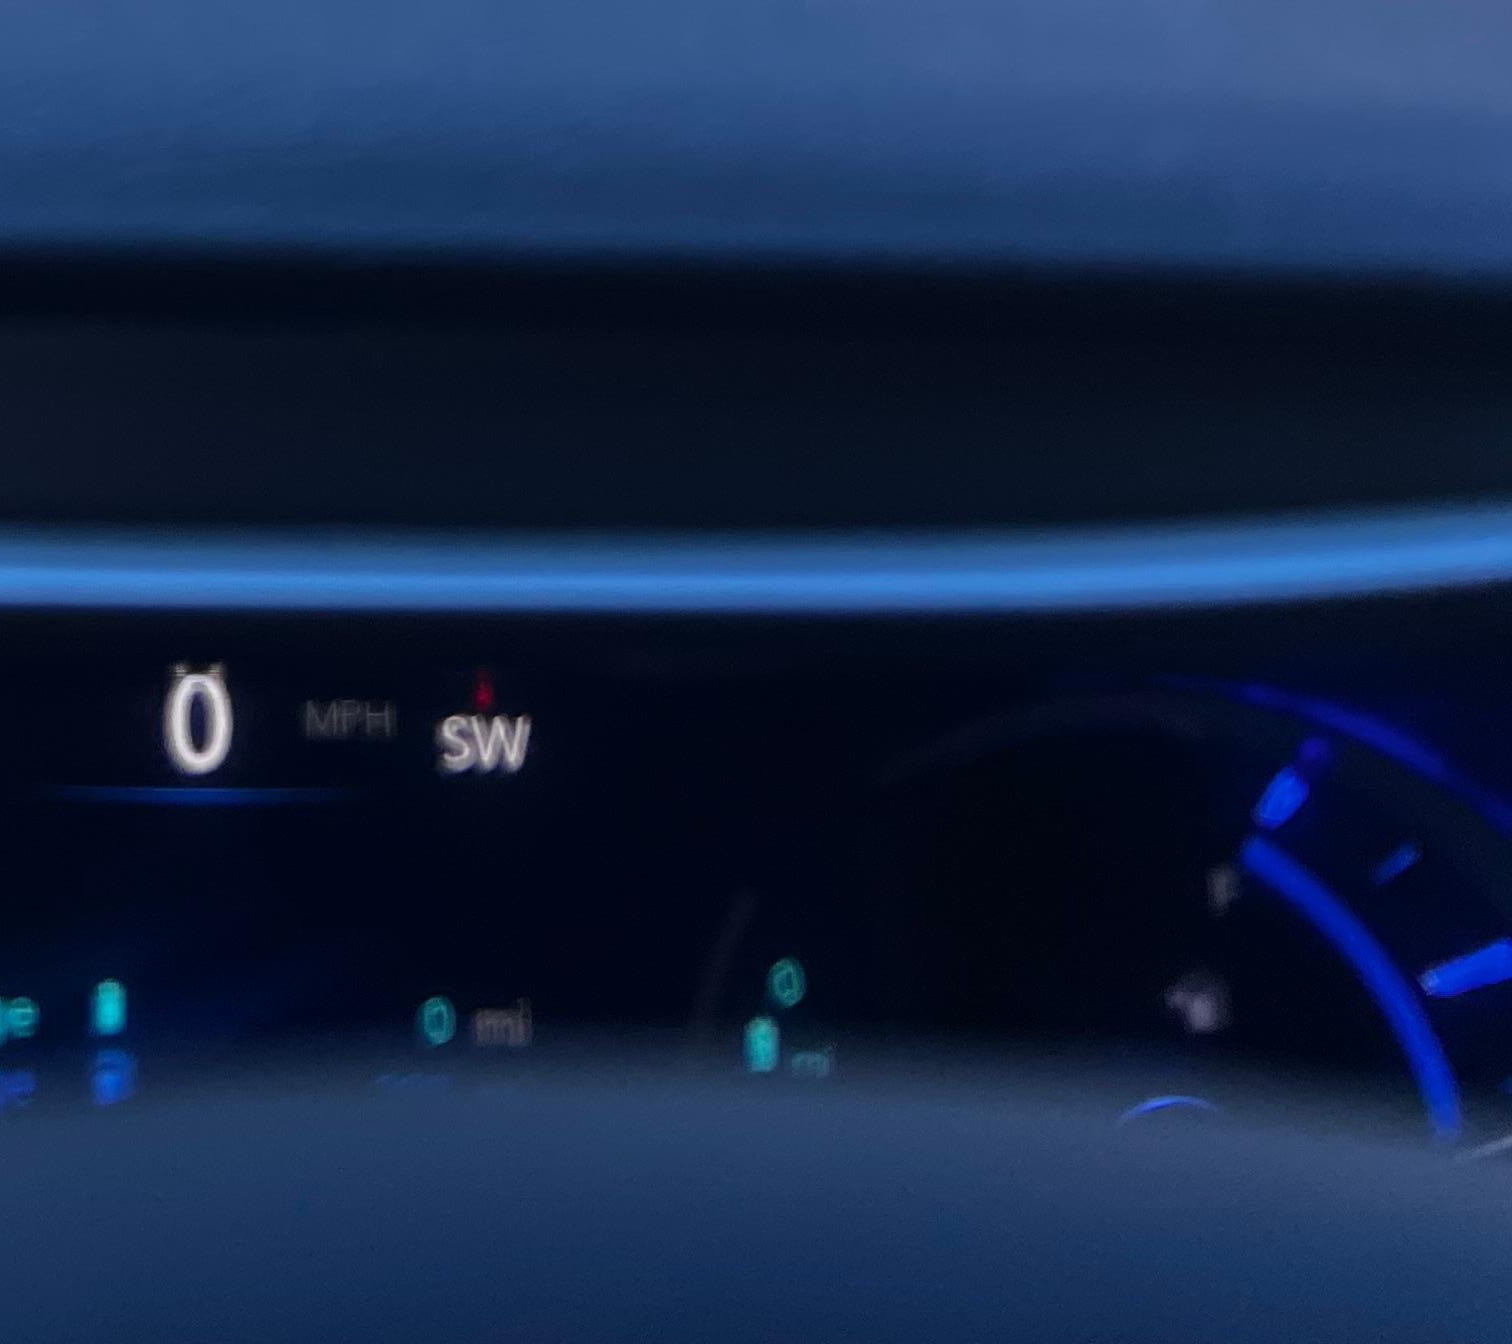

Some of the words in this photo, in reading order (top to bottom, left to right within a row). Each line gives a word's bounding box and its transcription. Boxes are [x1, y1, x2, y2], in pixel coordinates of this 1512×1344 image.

[164, 670, 234, 776] 0
[305, 699, 395, 739] MPH
[434, 714, 532, 775] SW
